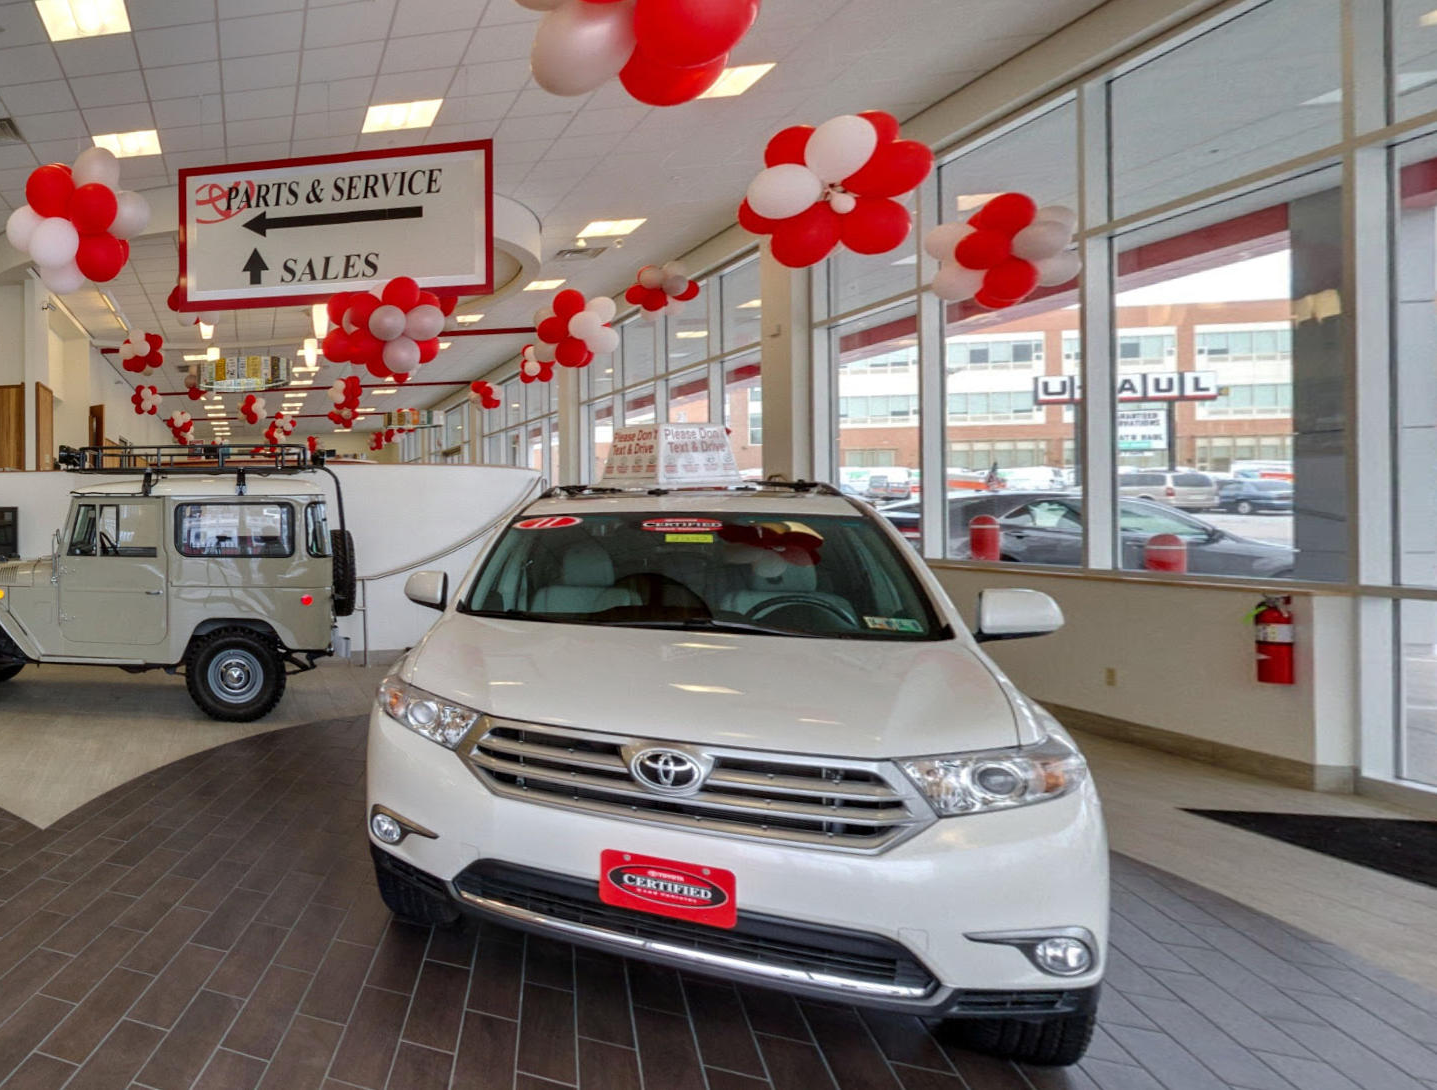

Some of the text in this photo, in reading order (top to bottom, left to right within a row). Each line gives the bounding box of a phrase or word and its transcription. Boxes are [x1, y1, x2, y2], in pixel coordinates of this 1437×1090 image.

[225, 168, 442, 211] PARTS & SERVICE
[280, 252, 380, 284] SALES
[614, 431, 636, 442] Please
[664, 428, 697, 440] Please
[613, 444, 627, 455] Text
[634, 443, 654, 454] Drive
[668, 442, 688, 453] Text
[701, 441, 726, 452] Drive
[623, 873, 713, 900] CERTIFIED
